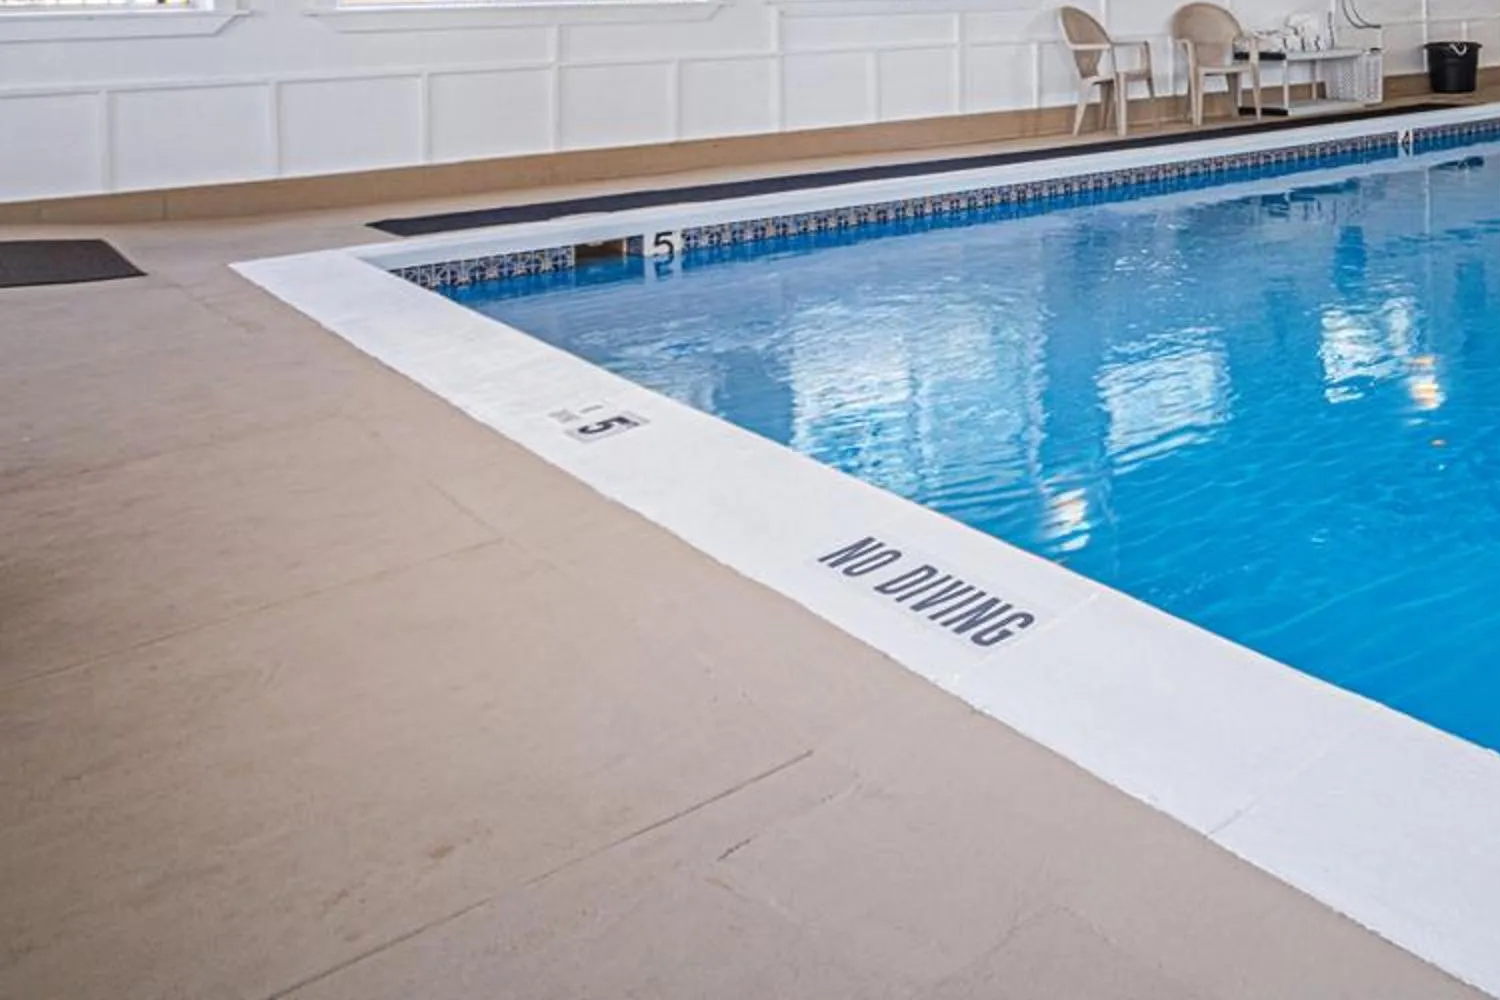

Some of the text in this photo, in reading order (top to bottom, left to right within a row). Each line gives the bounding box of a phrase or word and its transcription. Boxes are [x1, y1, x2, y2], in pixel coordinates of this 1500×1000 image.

[653, 231, 676, 262] 5
[578, 416, 640, 435] 5
[817, 536, 1035, 647] NO DIVING
